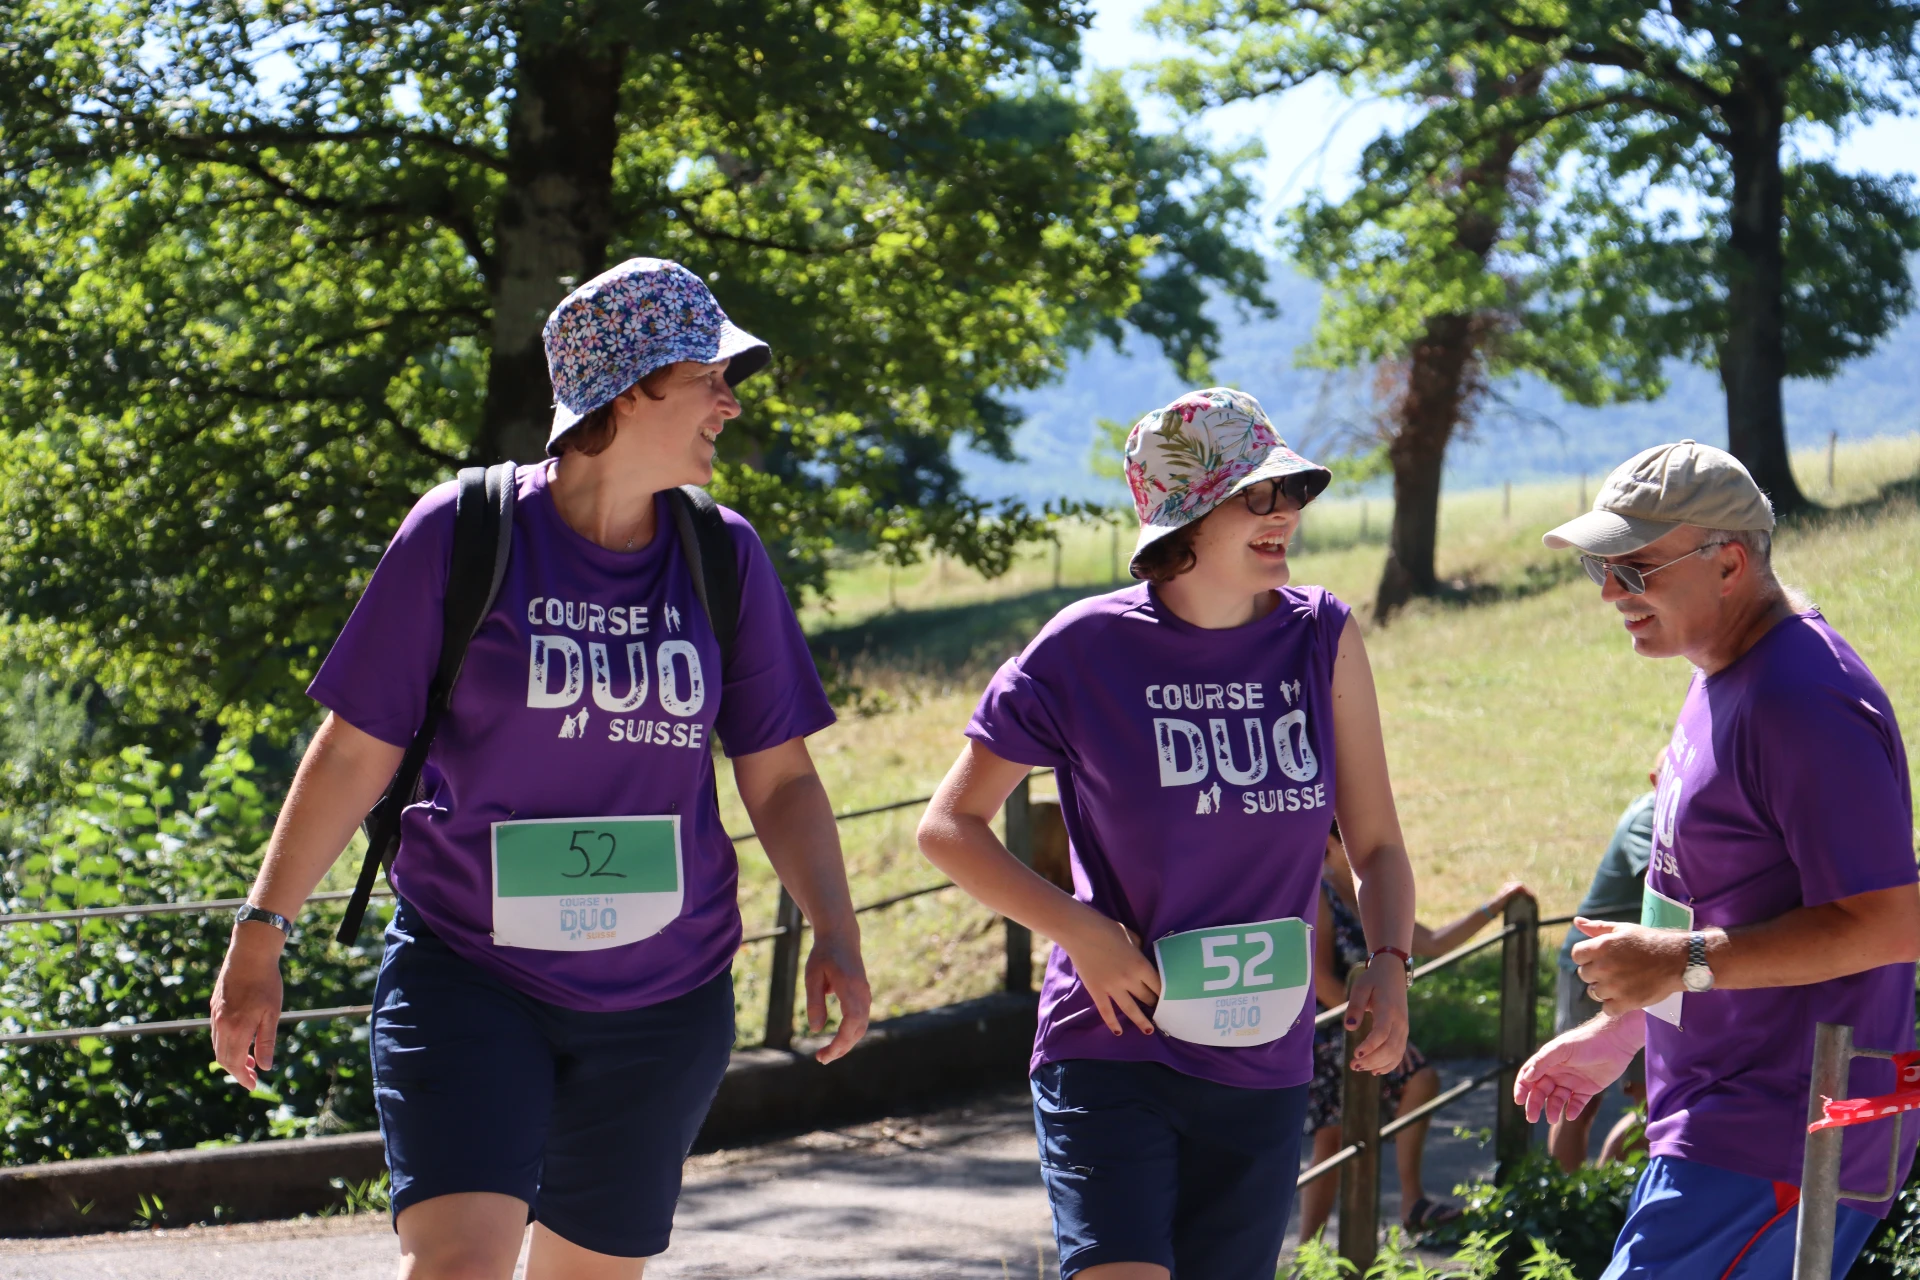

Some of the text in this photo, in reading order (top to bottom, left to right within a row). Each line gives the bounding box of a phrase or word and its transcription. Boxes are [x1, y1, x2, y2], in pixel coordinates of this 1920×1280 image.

[528, 597, 649, 636] COURSE
[527, 634, 705, 717] DUO
[1145, 682, 1265, 710] COURSE
[608, 718, 703, 749] SUISSE
[1153, 709, 1318, 787] DUO
[1242, 783, 1326, 815] SUISSE
[561, 830, 627, 878] 52
[560, 897, 600, 907] COURSE
[560, 908, 617, 931] DUO
[586, 931, 617, 940] SUISSE
[1201, 931, 1274, 991] 52
[1214, 1005, 1261, 1030] DUO
[1215, 996, 1249, 1008] COURSE
